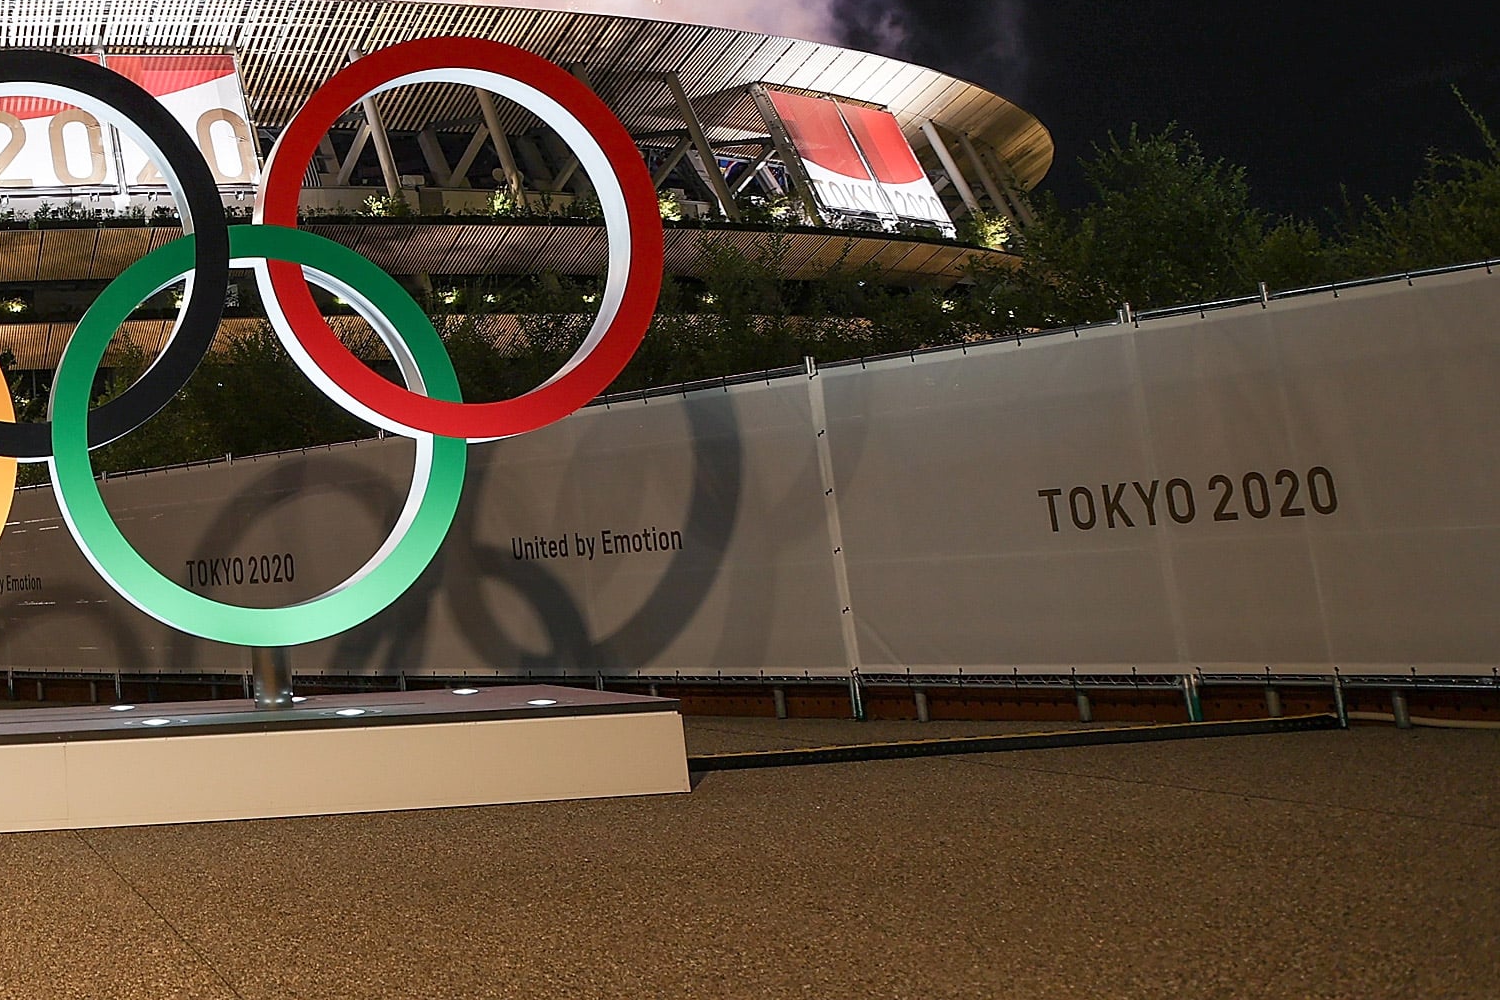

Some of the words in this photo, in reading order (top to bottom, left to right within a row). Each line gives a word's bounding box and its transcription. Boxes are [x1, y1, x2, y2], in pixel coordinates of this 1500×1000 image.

[1038, 477, 1196, 532] TOKYO
[1208, 466, 1338, 521] 2020
[512, 534, 569, 560] United
[575, 533, 595, 560] by
[601, 527, 683, 554] Emotion
[6, 574, 42, 591] Emotion
[186, 557, 244, 587] TOKYO
[248, 553, 294, 584] 2020
